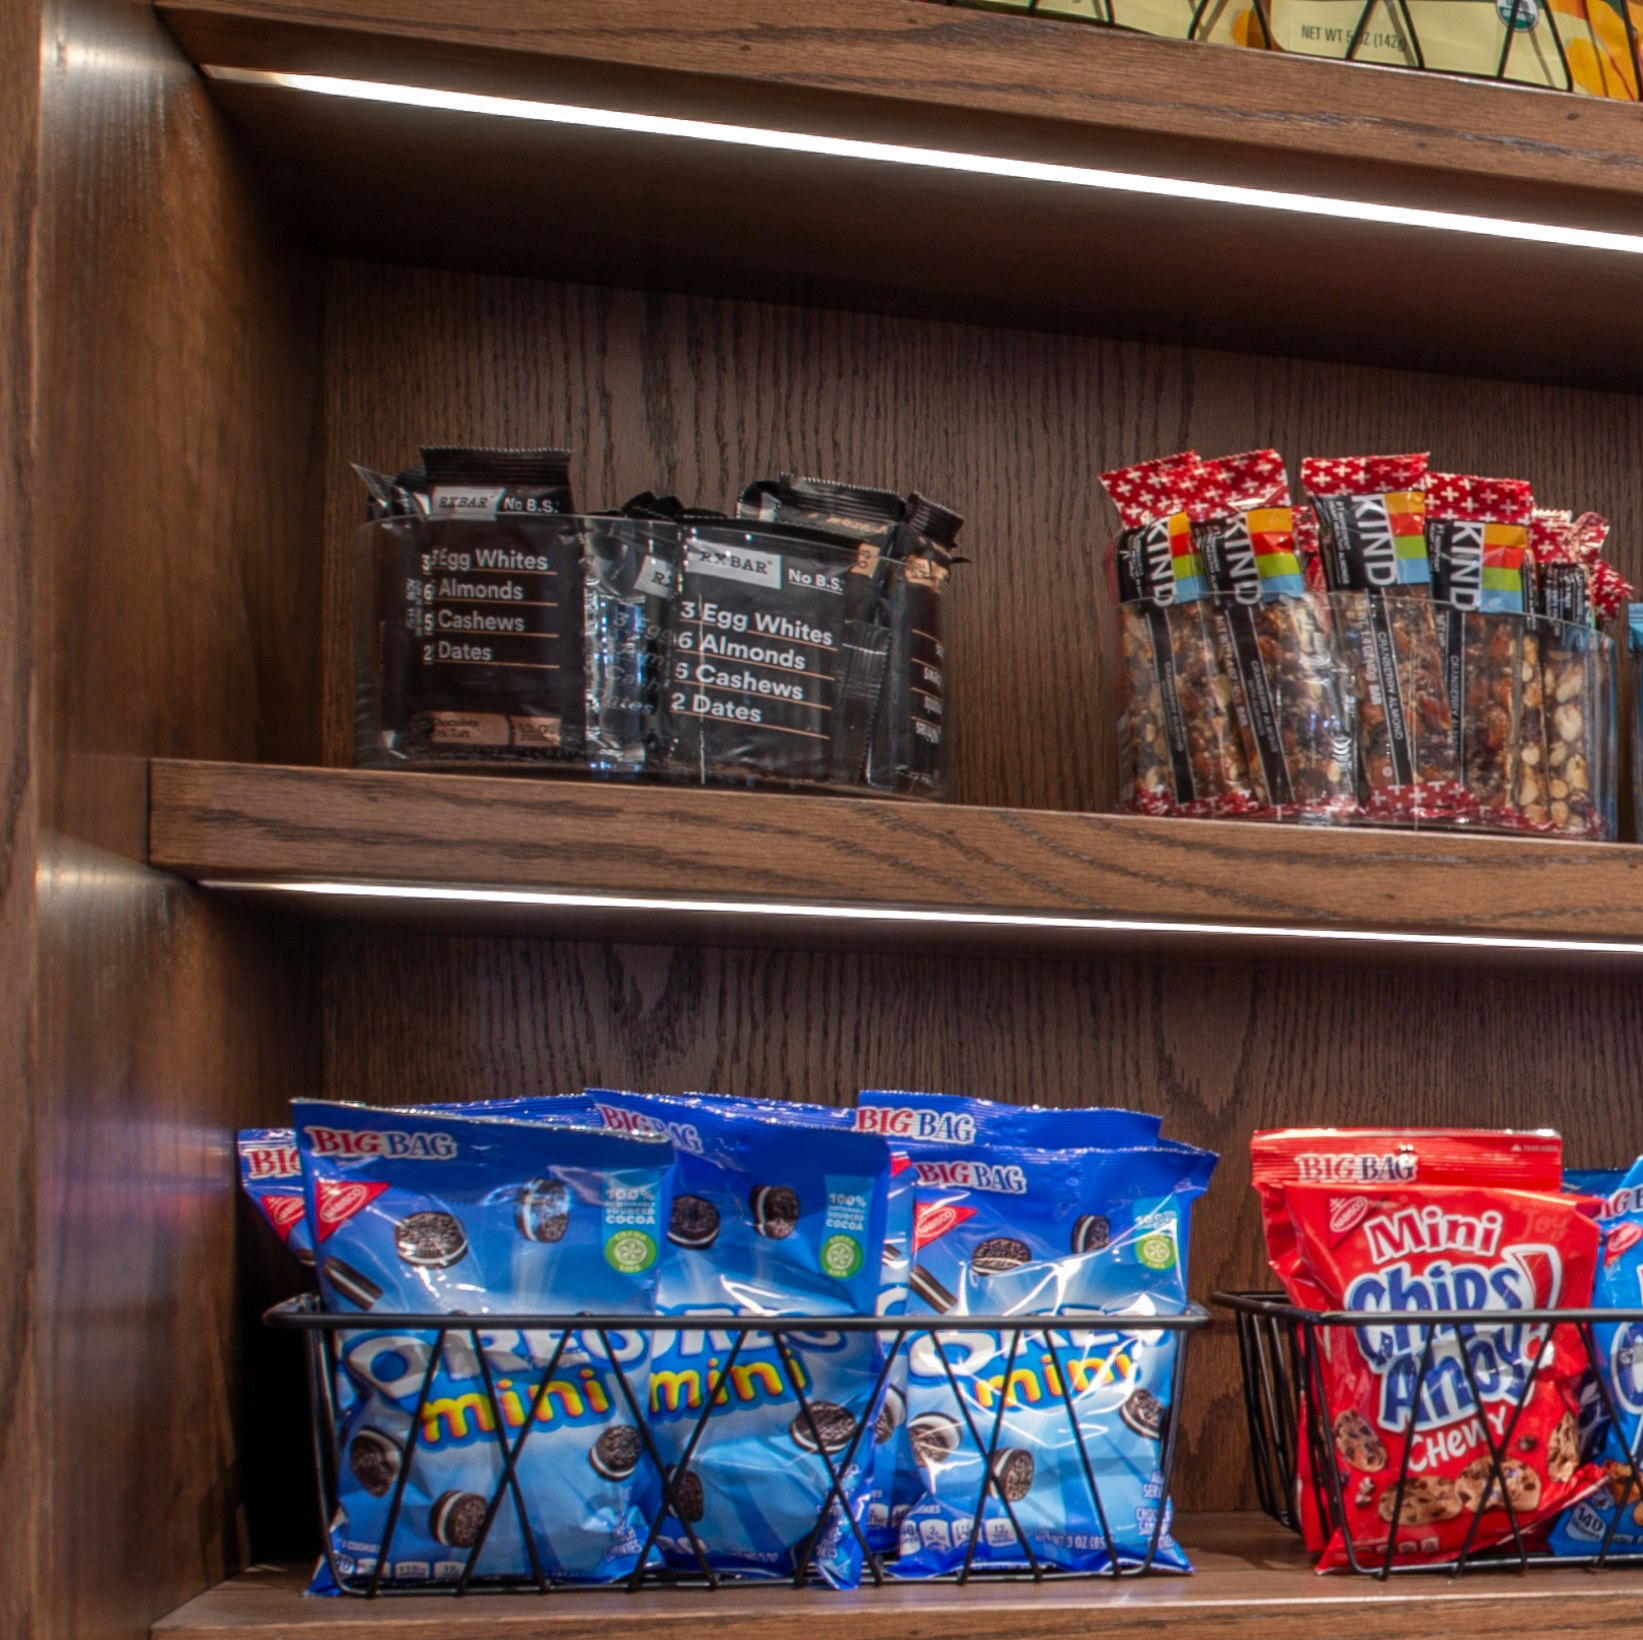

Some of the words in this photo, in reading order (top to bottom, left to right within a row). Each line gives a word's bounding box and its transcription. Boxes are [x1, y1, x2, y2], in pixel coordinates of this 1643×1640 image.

[1352, 494, 1396, 587] KIND
[475, 549, 548, 571] Whites
[1450, 521, 1482, 612] KIND
[439, 580, 524, 601] Almonds
[423, 613, 434, 632] 5
[438, 611, 524, 632] Cashews
[680, 602, 697, 620] 3
[701, 604, 749, 632] Egg
[754, 612, 834, 645] Whites
[423, 645, 432, 663] 2
[438, 642, 492, 662] Dates
[677, 631, 693, 650] 6
[699, 634, 806, 671] Almonds
[675, 664, 690, 681] 5
[696, 665, 804, 701] Cashews
[672, 693, 687, 710] 2
[691, 695, 763, 723] Dates
[856, 1108, 913, 1132] BIG
[914, 1109, 976, 1143] BAG
[306, 1127, 383, 1155] BIG
[383, 1132, 457, 1159] BAG
[916, 1162, 971, 1185] BIG
[972, 1164, 1026, 1194] BAG
[605, 1214, 655, 1225] COCOA
[826, 1219, 865, 1231] COCOA
[1364, 1207, 1501, 1264] Mini
[423, 1367, 609, 1444] mini
